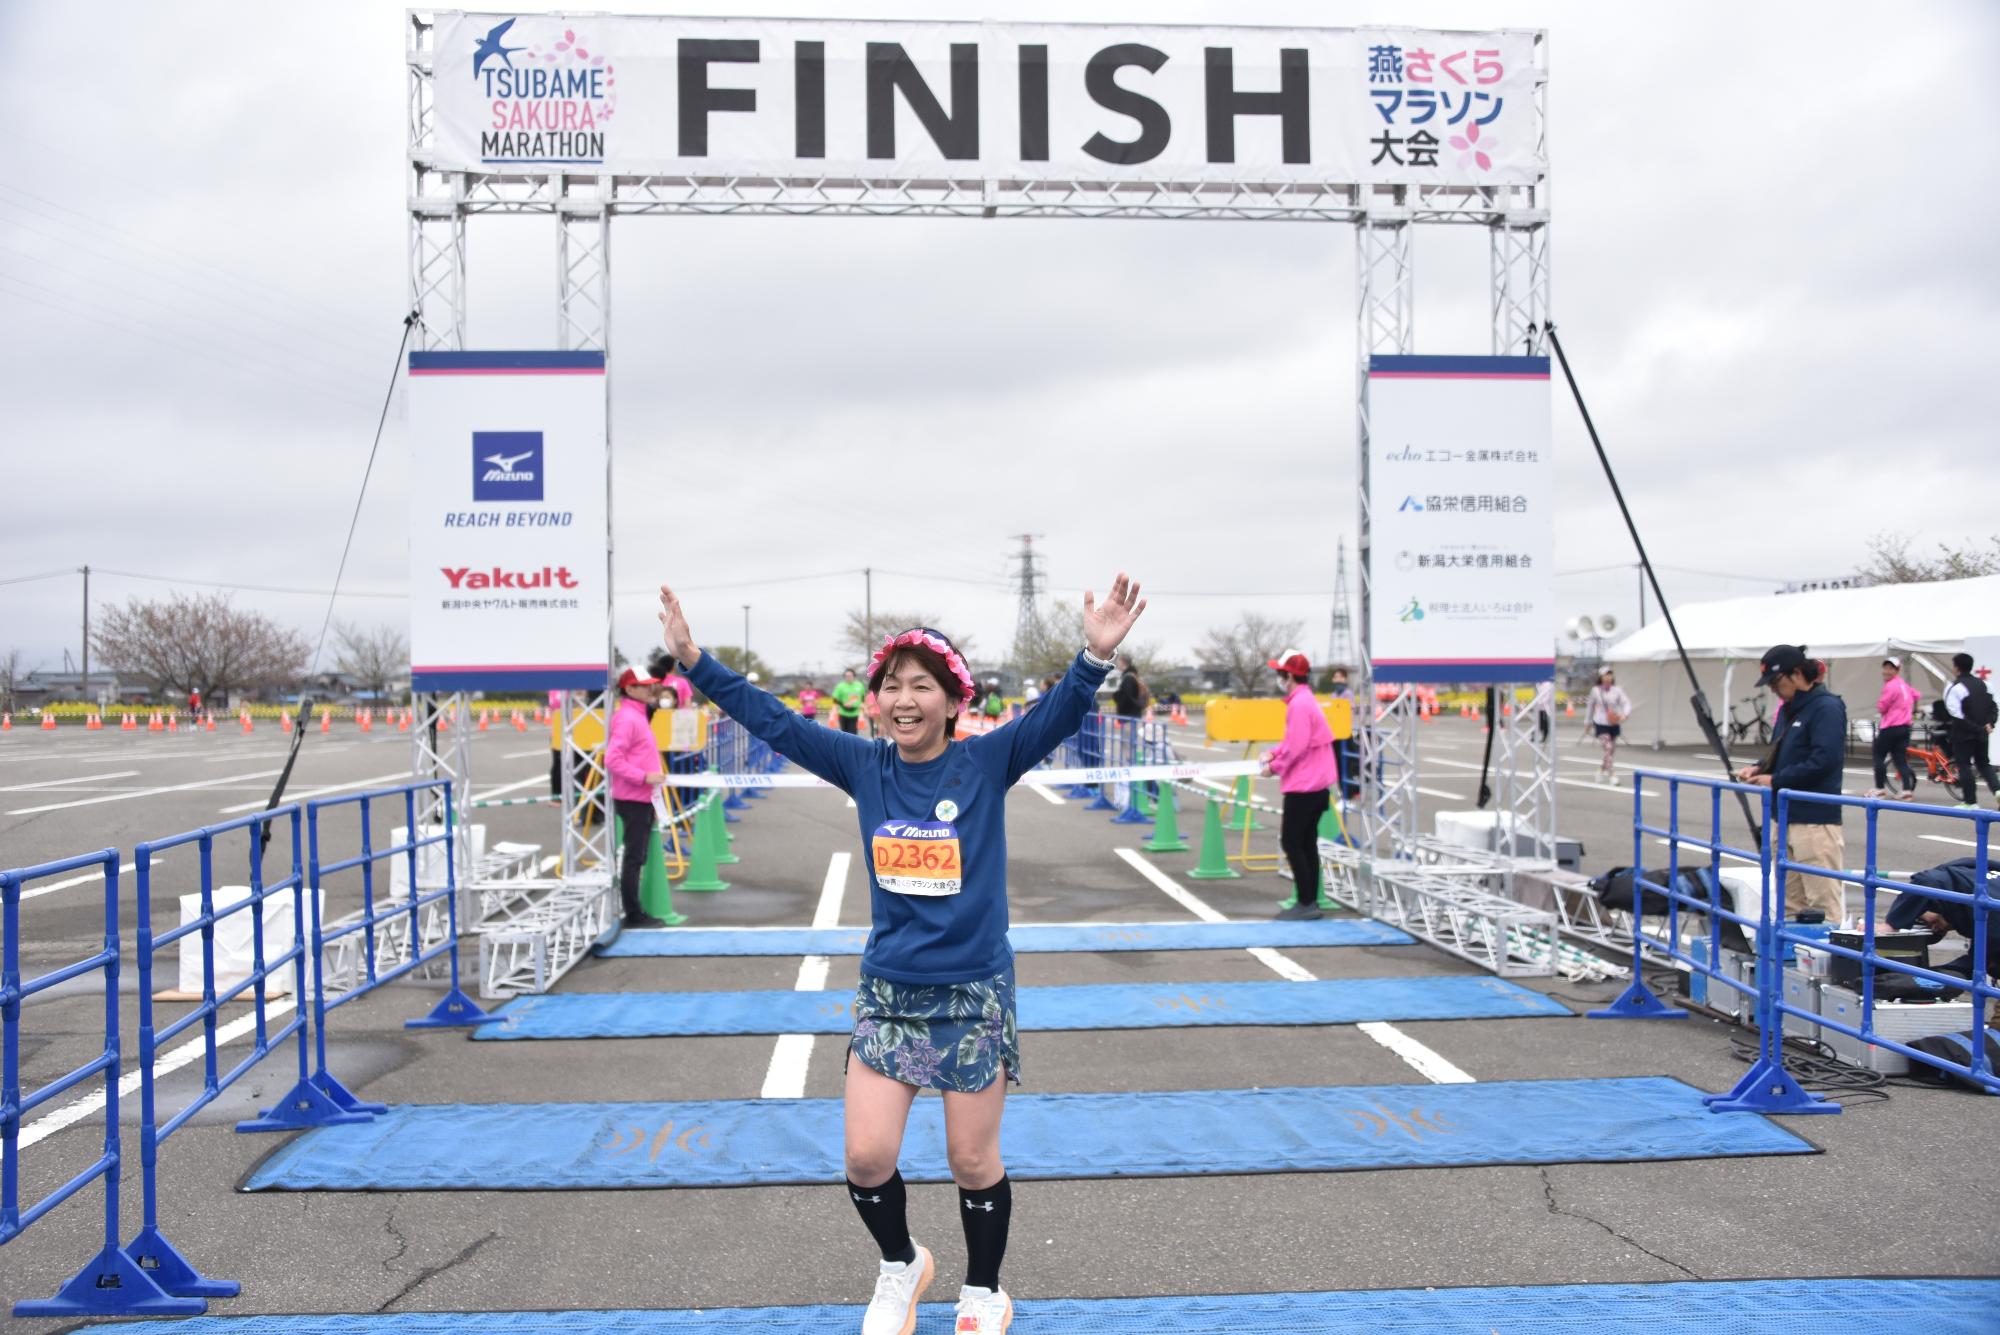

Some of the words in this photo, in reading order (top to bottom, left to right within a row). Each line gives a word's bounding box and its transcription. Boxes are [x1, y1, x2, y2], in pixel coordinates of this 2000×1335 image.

[1368, 45, 1504, 85] 燕さくら
[481, 68, 604, 98] TSUBAME
[492, 100, 596, 130] SAKURA
[677, 38, 1311, 165] FINISH
[1370, 90, 1504, 125] マラソン
[481, 131, 604, 157] MARATHON
[1370, 129, 1440, 167] 大会
[1426, 495, 1527, 513] 協栄信用組合
[444, 512, 501, 528] REACH
[505, 512, 573, 528] BEYOND
[1418, 554, 1532, 569] 新潟大栄信用組合
[440, 567, 579, 589] Yakult
[877, 843, 956, 870] D2362
